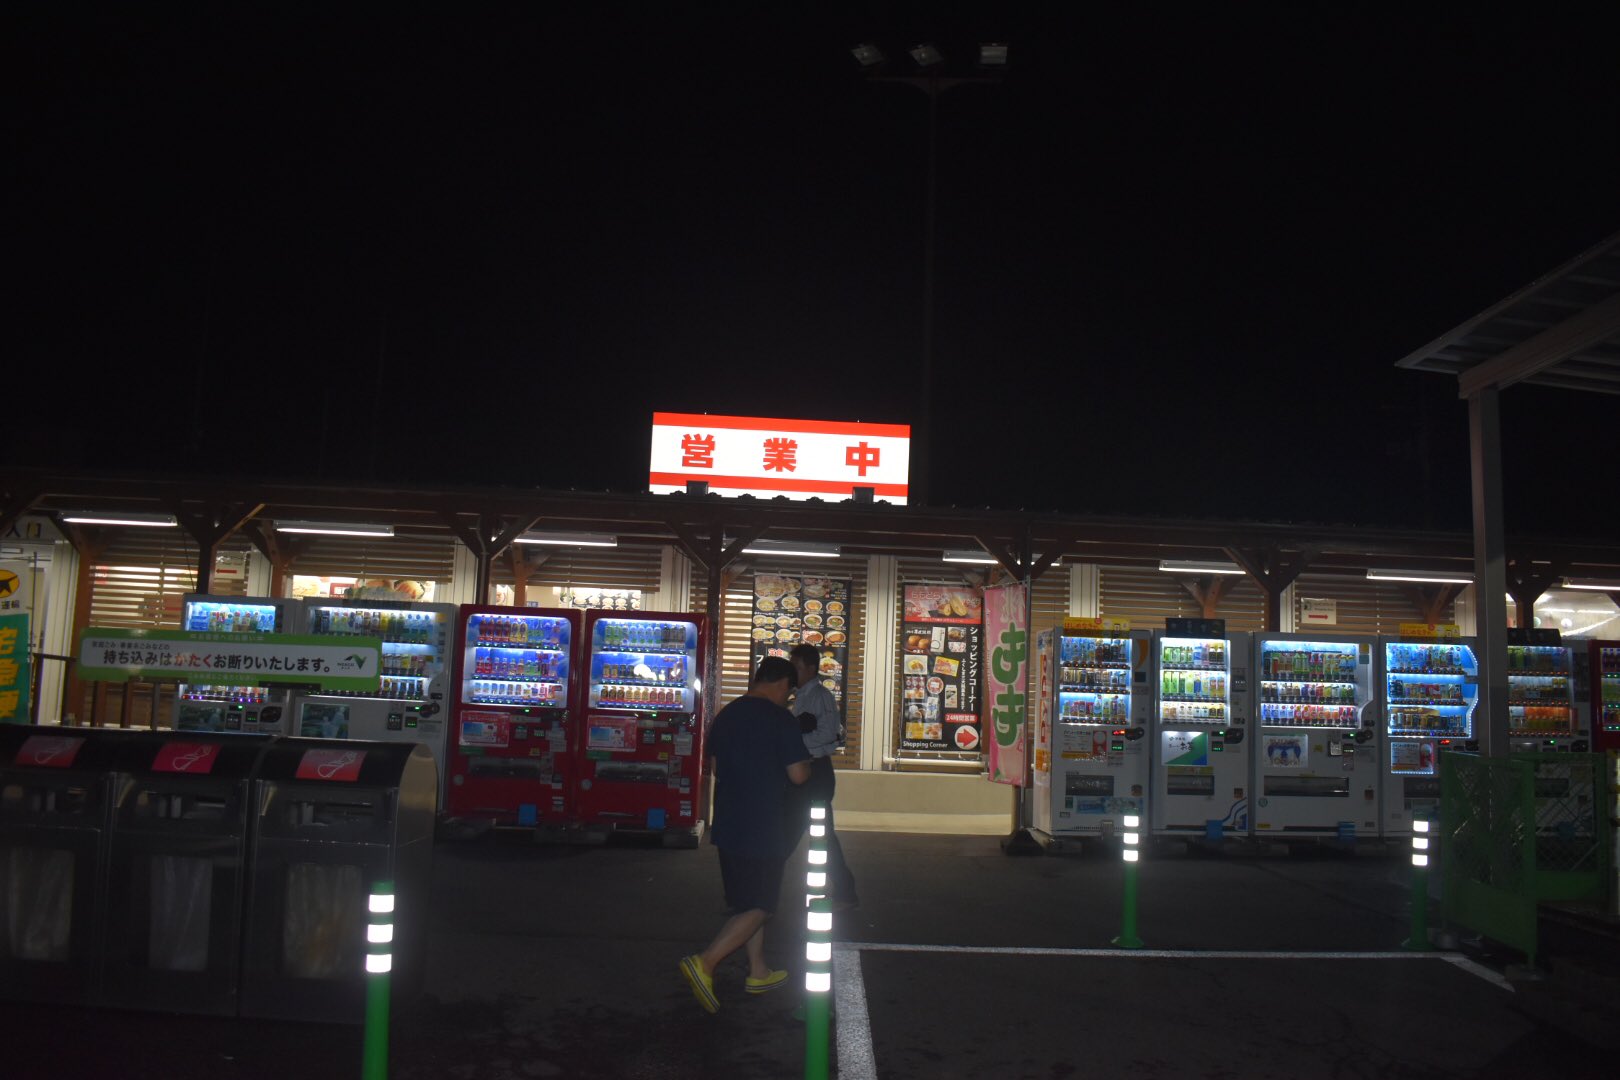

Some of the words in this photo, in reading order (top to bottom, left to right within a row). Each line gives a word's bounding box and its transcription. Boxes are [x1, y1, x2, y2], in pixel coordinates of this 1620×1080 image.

[681, 434, 880, 477] 営業中
[103, 649, 330, 672] 持ち込みはかたくお断りいたします。
[968, 627, 978, 711] ショッピングコーナー
[903, 741, 927, 750] Shopping
